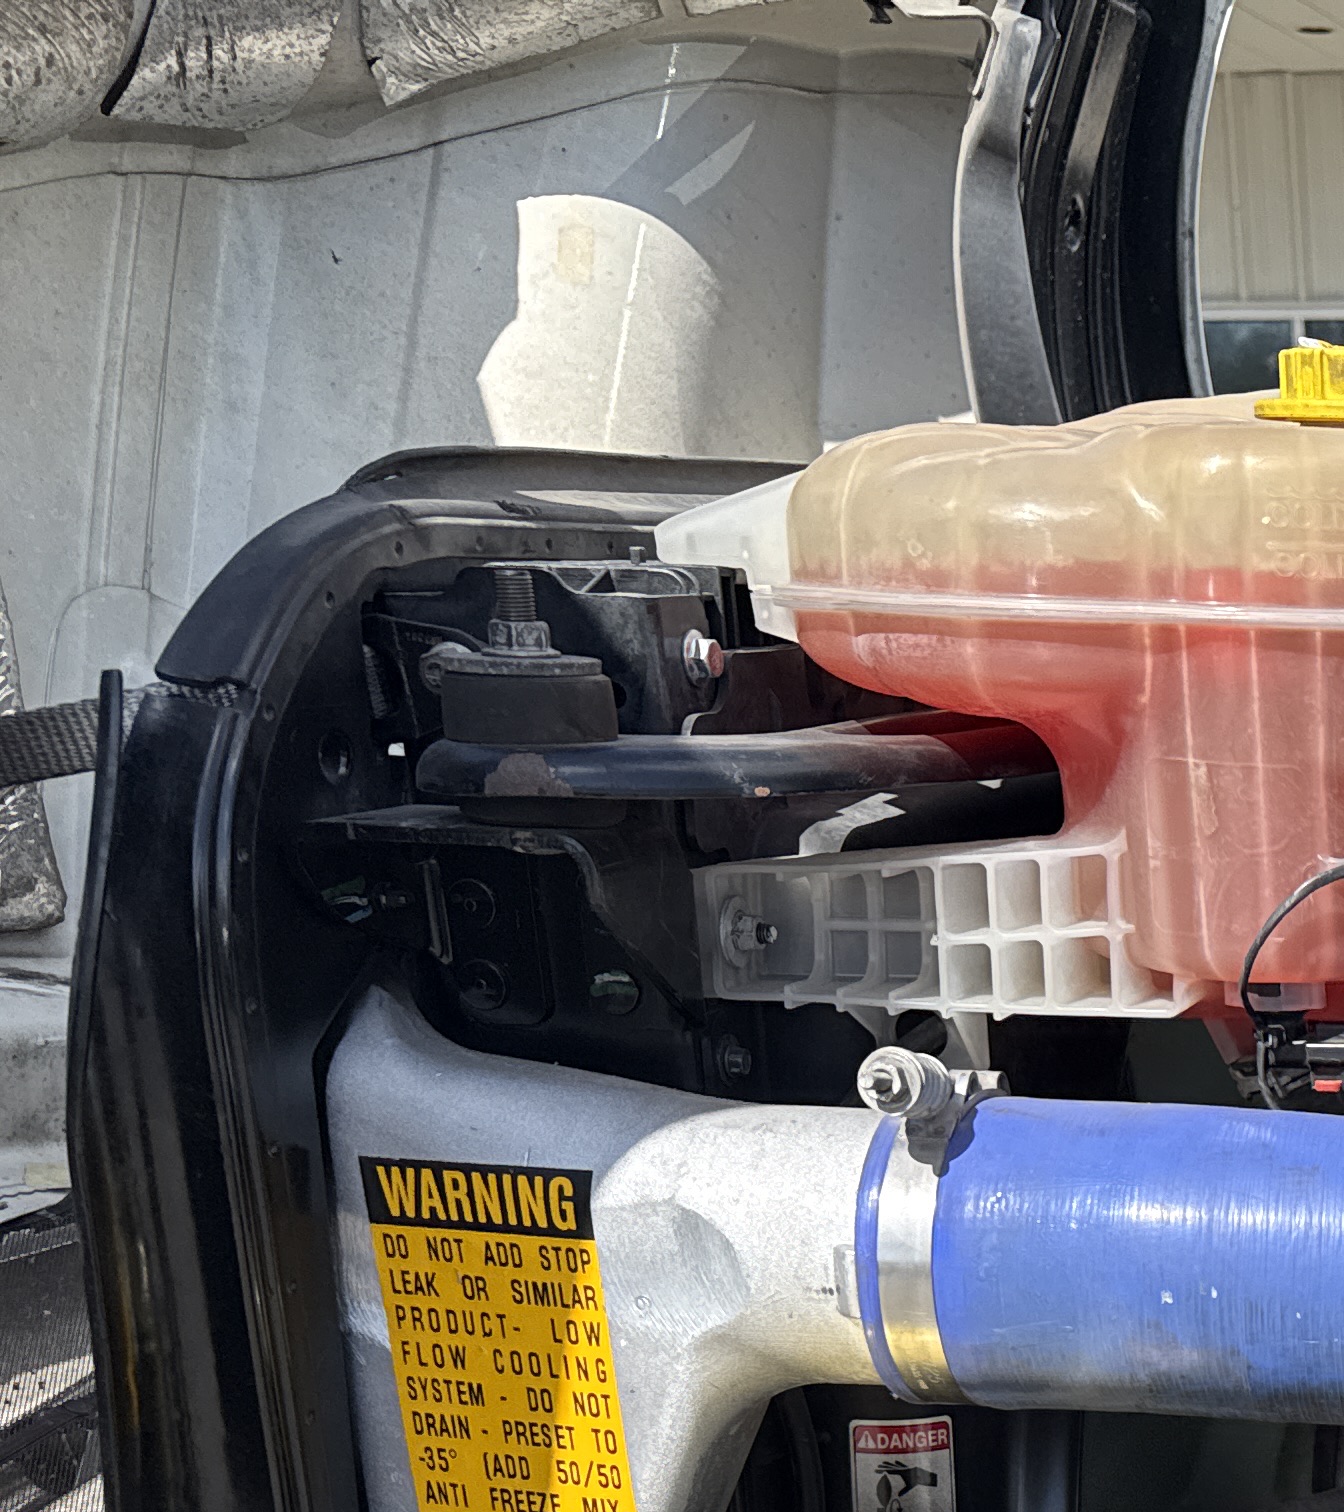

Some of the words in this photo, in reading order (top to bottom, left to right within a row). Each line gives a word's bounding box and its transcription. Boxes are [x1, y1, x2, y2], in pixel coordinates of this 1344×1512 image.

[375, 1165, 578, 1232] WARNING
[382, 1231, 410, 1260] DO
[425, 1235, 464, 1264] NOT
[483, 1240, 523, 1269] ADD
[538, 1244, 592, 1275] STOP
[389, 1267, 440, 1298] LEAK
[461, 1273, 490, 1302] OR
[509, 1278, 599, 1311] SIMILAR
[395, 1303, 521, 1340] PRODUCT-
[550, 1317, 601, 1348] LOW
[401, 1340, 467, 1371] FLOW
[491, 1347, 608, 1384] COOLING
[405, 1375, 486, 1408] SYSTEM
[525, 1385, 554, 1414] DO
[571, 1390, 611, 1420] NOT
[411, 1410, 472, 1441] DRAIN
[501, 1419, 575, 1452] PRESET
[590, 1427, 618, 1456] TO
[876, 1428, 949, 1450] DANGER
[418, 1445, 457, 1473] -35°
[482, 1451, 532, 1482] (ADD
[555, 1458, 623, 1491] 50/50
[425, 1479, 469, 1509] ANTI
